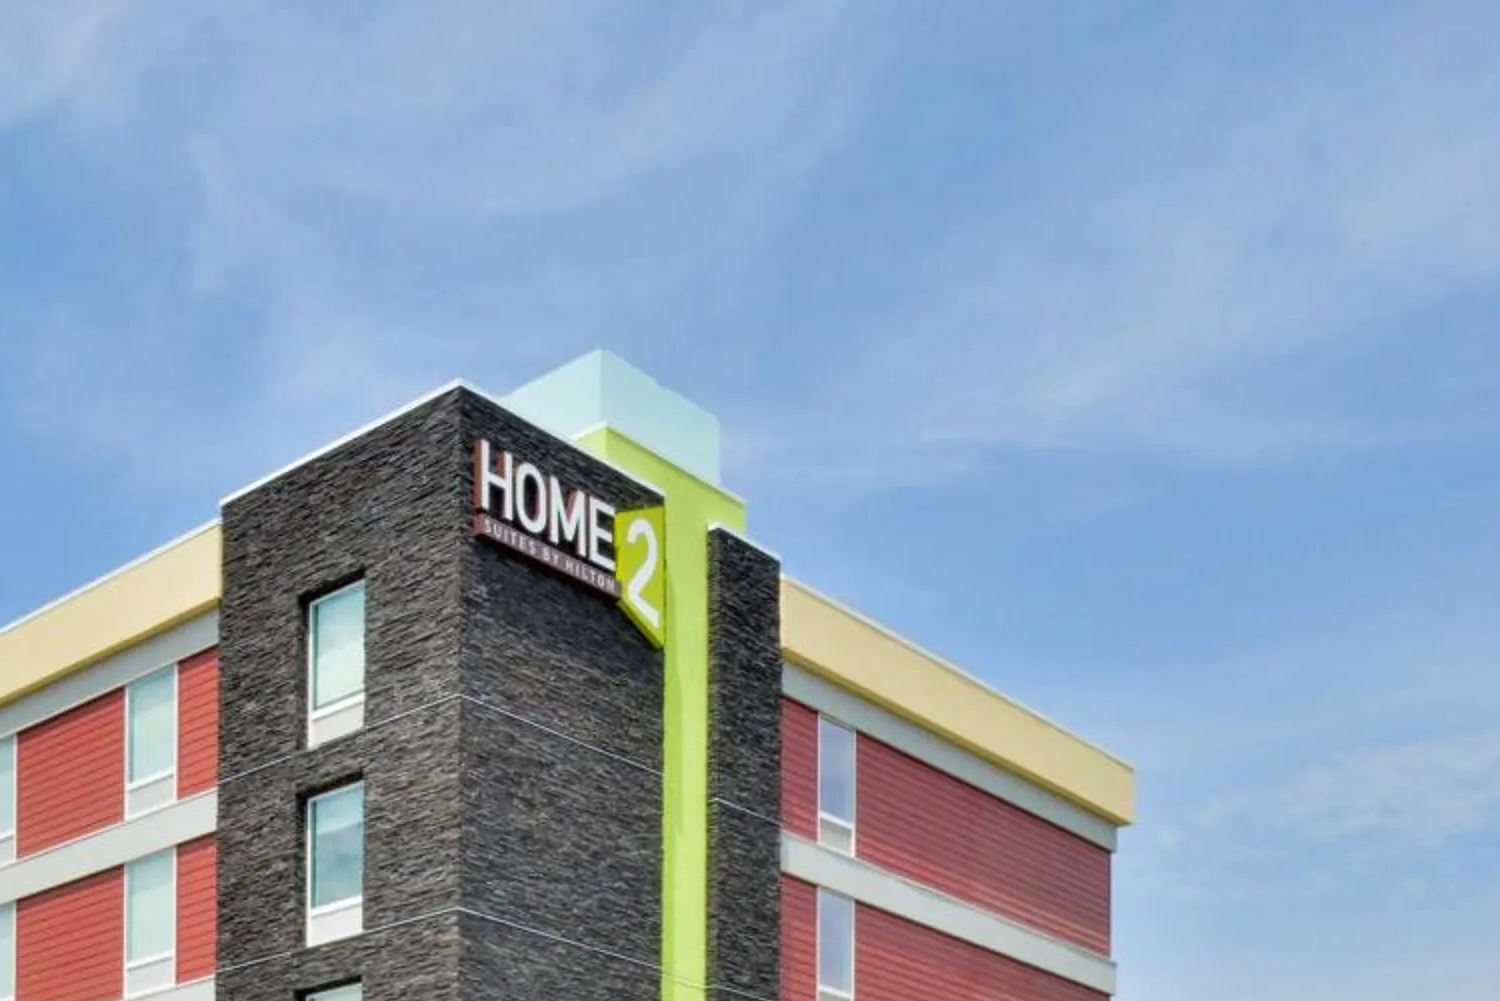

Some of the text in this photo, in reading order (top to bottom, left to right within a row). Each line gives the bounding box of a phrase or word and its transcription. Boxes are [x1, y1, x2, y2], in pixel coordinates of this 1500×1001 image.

[484, 519, 617, 592] SUITES BY HILTON
